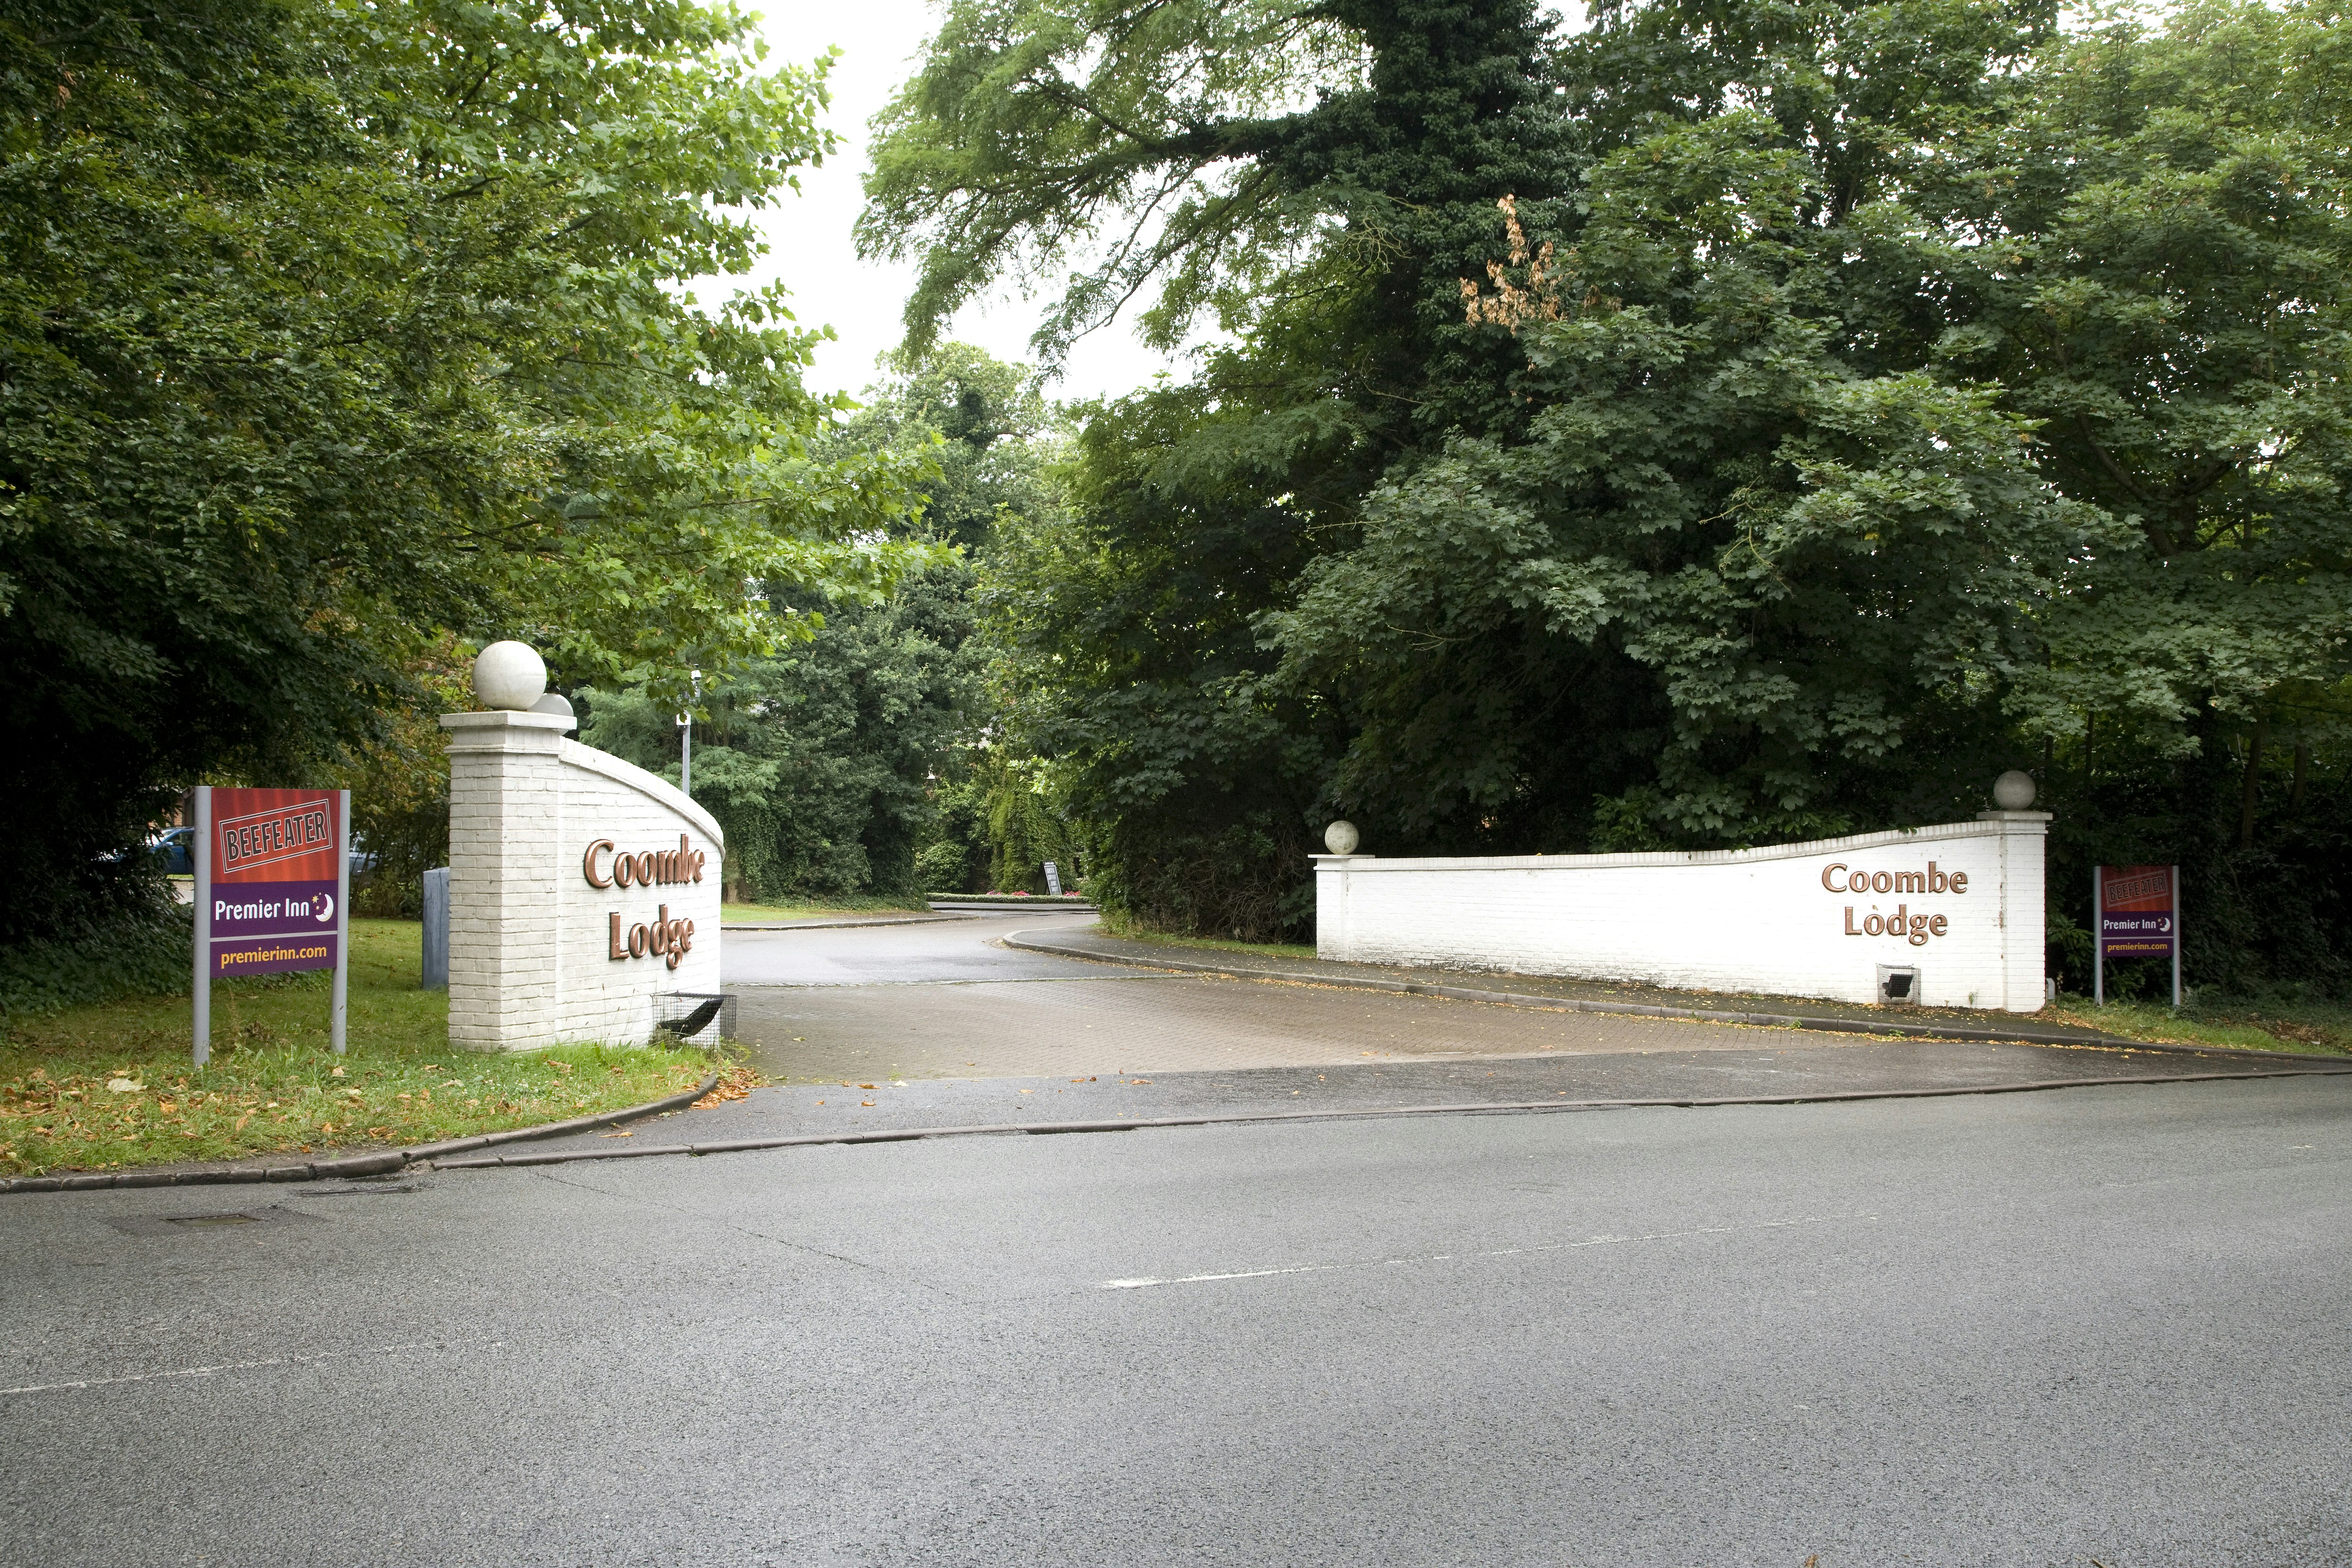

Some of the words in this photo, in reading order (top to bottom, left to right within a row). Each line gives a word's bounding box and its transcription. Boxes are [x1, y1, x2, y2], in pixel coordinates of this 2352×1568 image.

[226, 811, 327, 862] BEEFEATER
[584, 833, 705, 888] Coombe
[1821, 861, 1968, 894] Coombe
[2108, 877, 2165, 902] BEEFEATER
[215, 899, 281, 921] Premier
[285, 898, 309, 917] Inn
[609, 904, 694, 971] Lodge
[1845, 904, 1948, 946] Lodge
[2104, 920, 2140, 930] Premier
[2142, 919, 2156, 929] Inn
[220, 945, 327, 969] premierinn.com
[2107, 943, 2168, 953] premierinn.com
